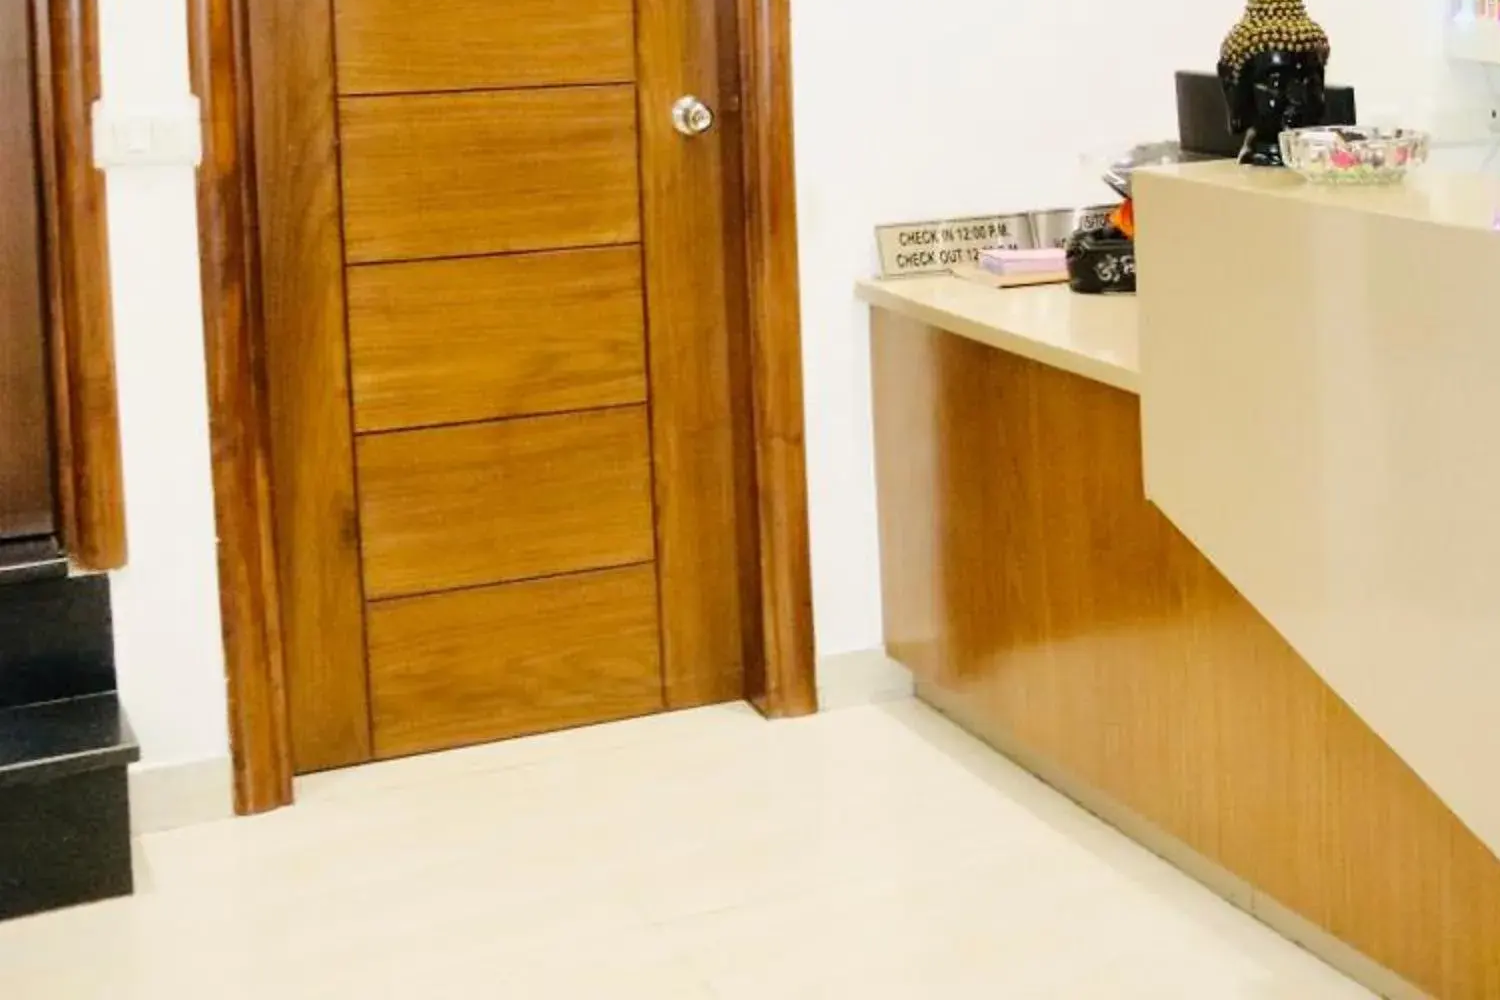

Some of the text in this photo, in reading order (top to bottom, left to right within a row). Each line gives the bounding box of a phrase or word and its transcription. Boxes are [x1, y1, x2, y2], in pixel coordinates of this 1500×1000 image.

[898, 230, 938, 247] CHECK
[941, 227, 955, 243] IN
[956, 224, 987, 241] 12:00
[896, 249, 936, 269] CHECK
[939, 247, 962, 265] OUT
